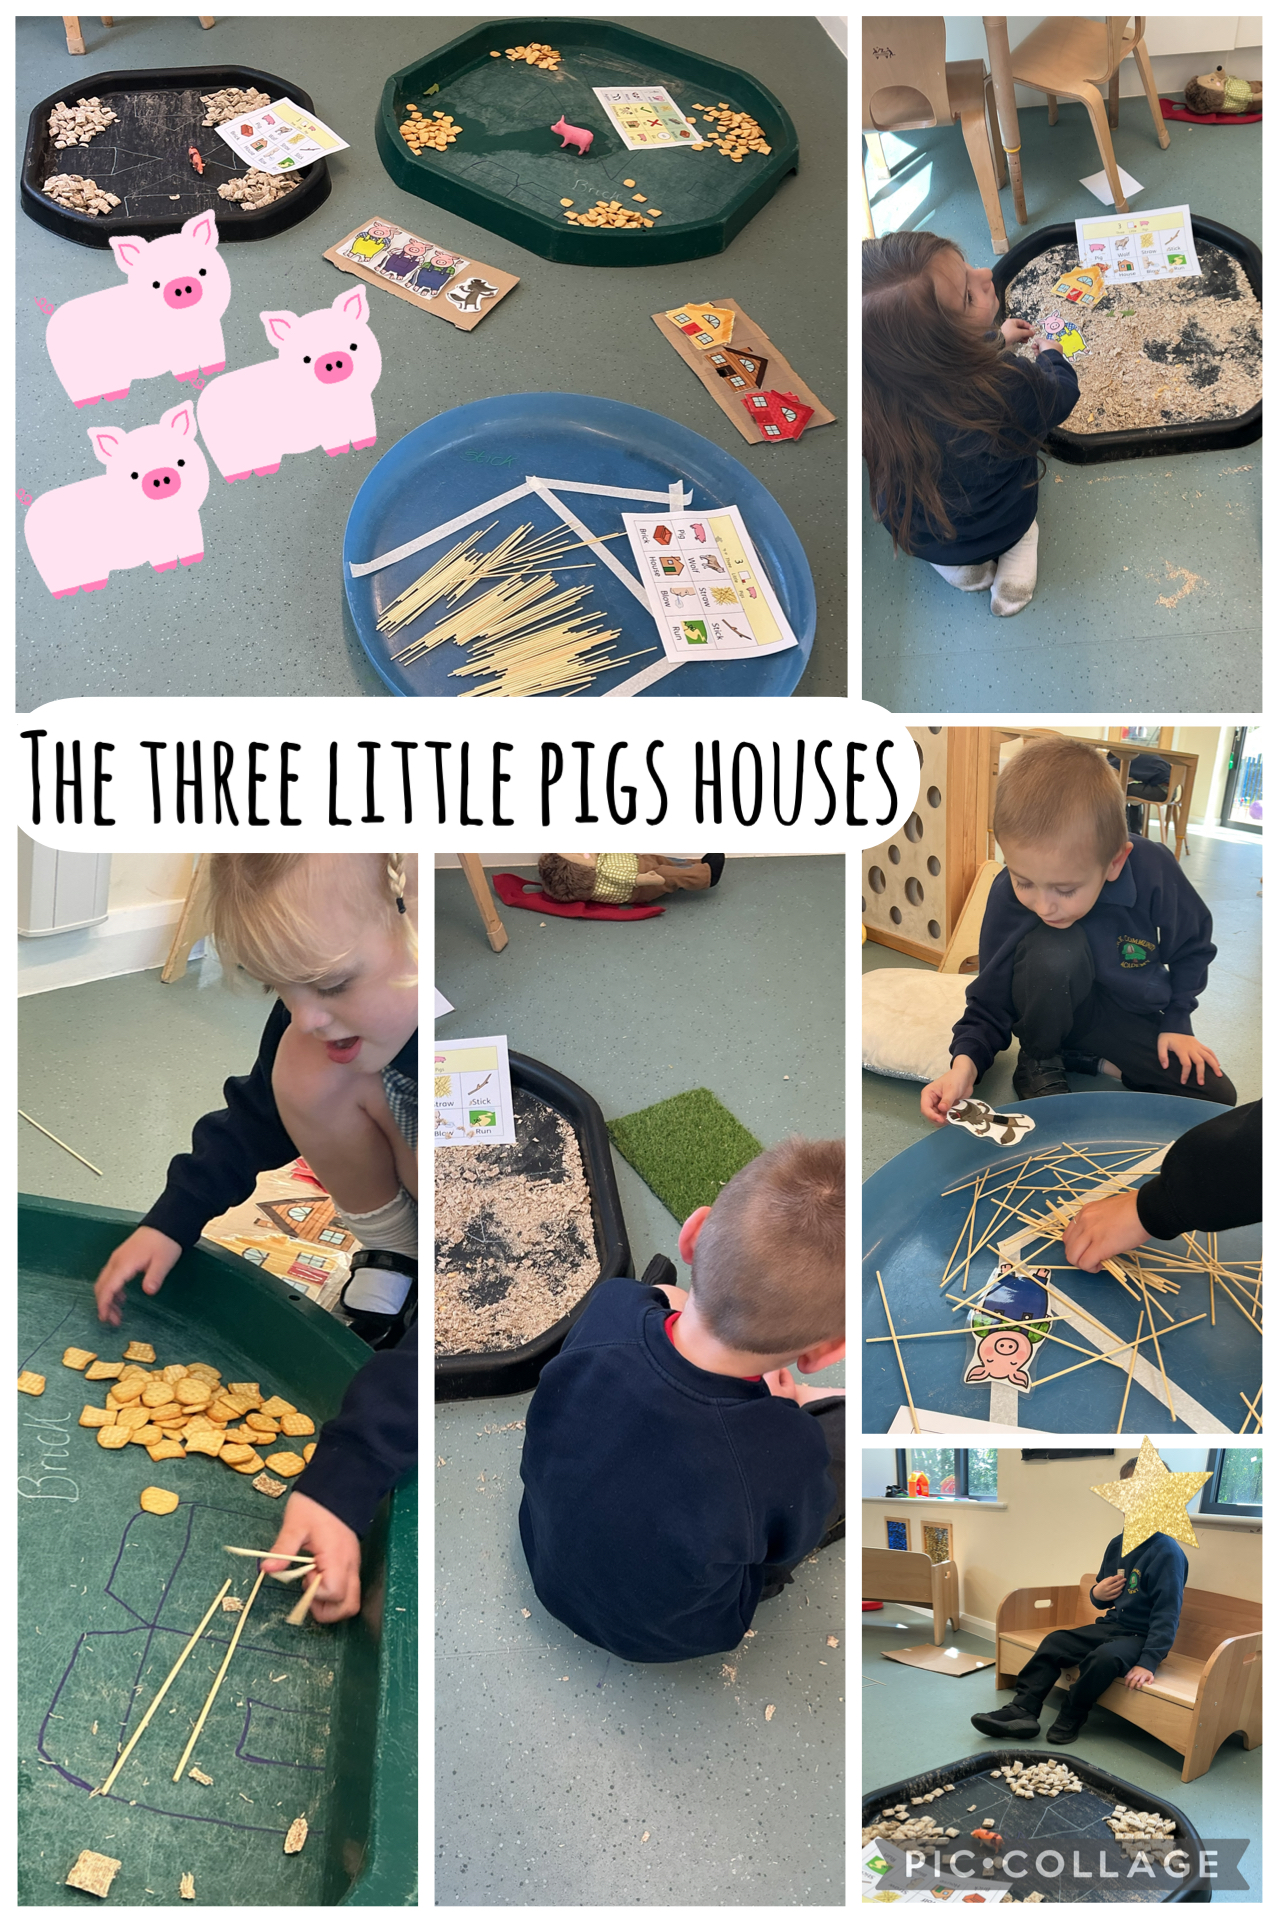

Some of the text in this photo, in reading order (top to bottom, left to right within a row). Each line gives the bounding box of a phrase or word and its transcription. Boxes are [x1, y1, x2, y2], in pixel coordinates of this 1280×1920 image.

[639, 528, 649, 544] Brick
[677, 529, 686, 540] Pig
[649, 556, 661, 577] House
[687, 557, 701, 574] Wolf
[660, 590, 671, 608] Blow
[698, 587, 711, 608] Straw
[672, 626, 682, 641] Run
[711, 622, 723, 641] Stick
[472, 1098, 492, 1106] Stick
[17, 1412, 79, 1503] Brick
